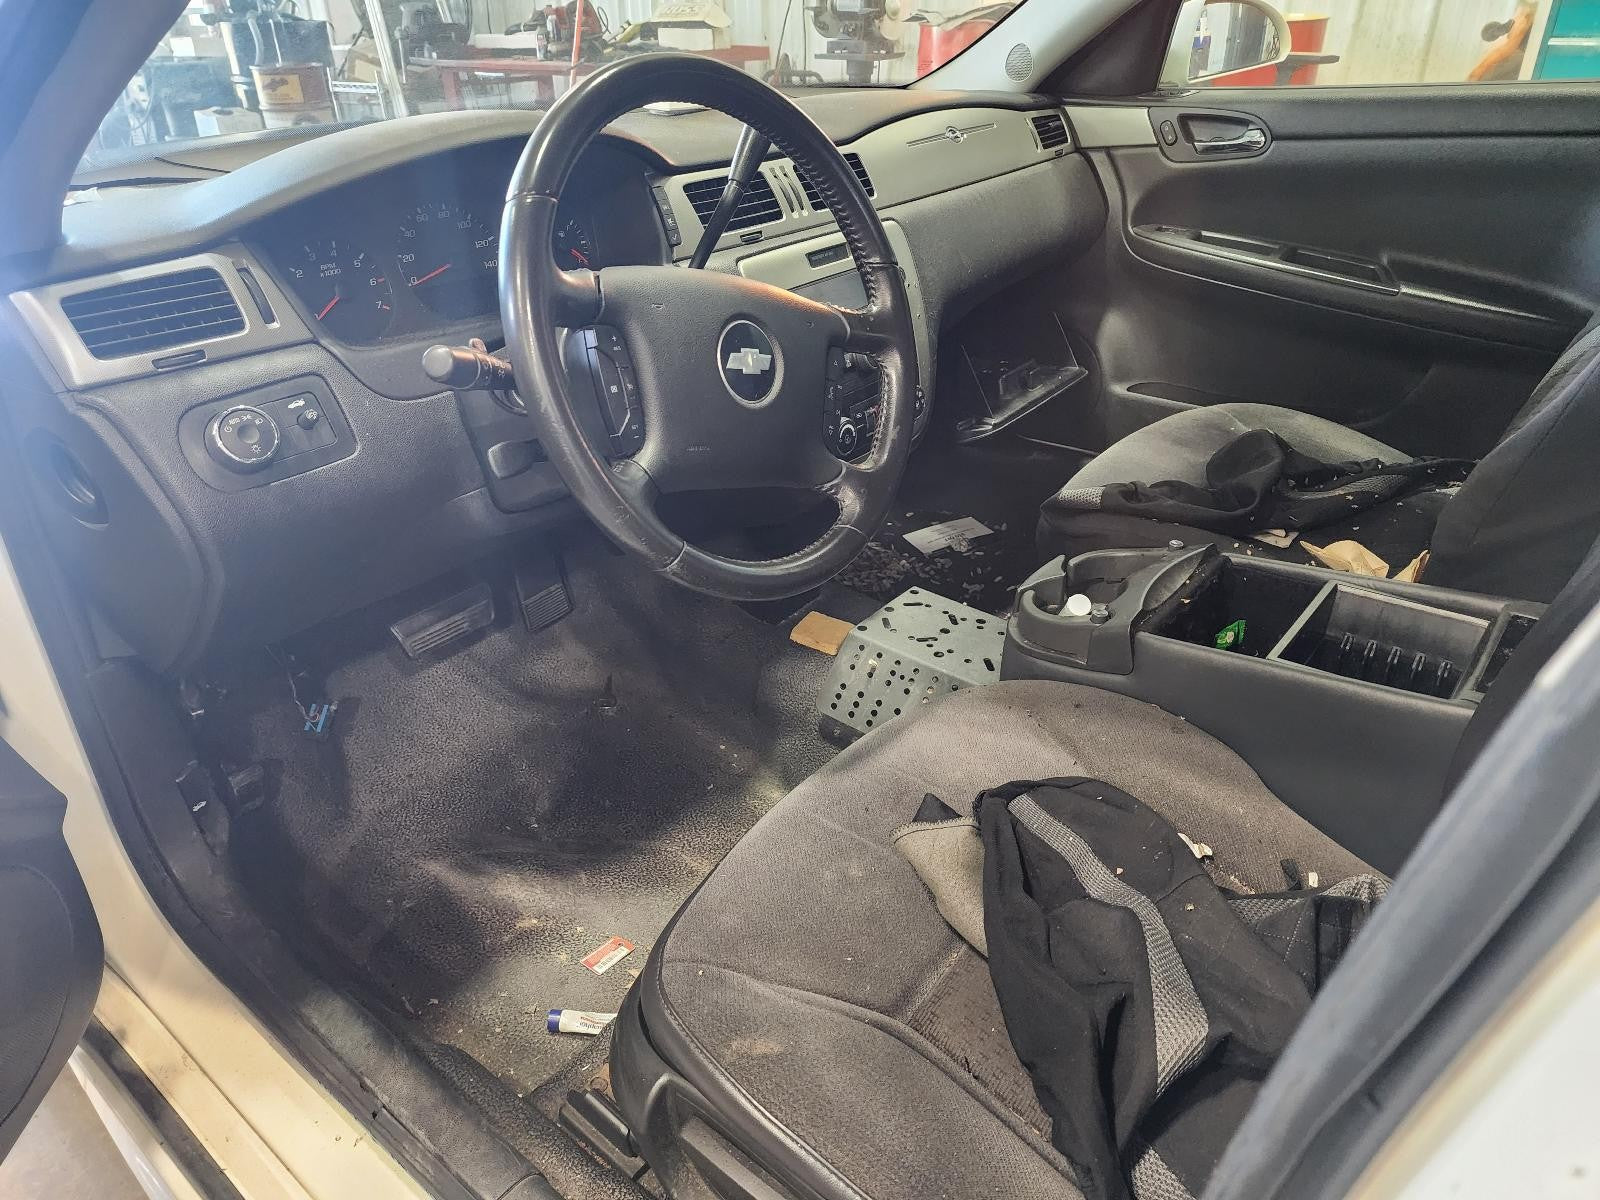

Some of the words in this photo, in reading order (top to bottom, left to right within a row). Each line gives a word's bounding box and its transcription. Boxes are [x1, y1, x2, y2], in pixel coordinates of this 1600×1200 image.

[416, 213, 429, 222] 60
[438, 210, 450, 218] 80
[457, 220, 472, 229] 100
[403, 229, 416, 238] 40
[475, 239, 489, 248] 120
[402, 253, 415, 262] 20
[484, 259, 498, 269] 140
